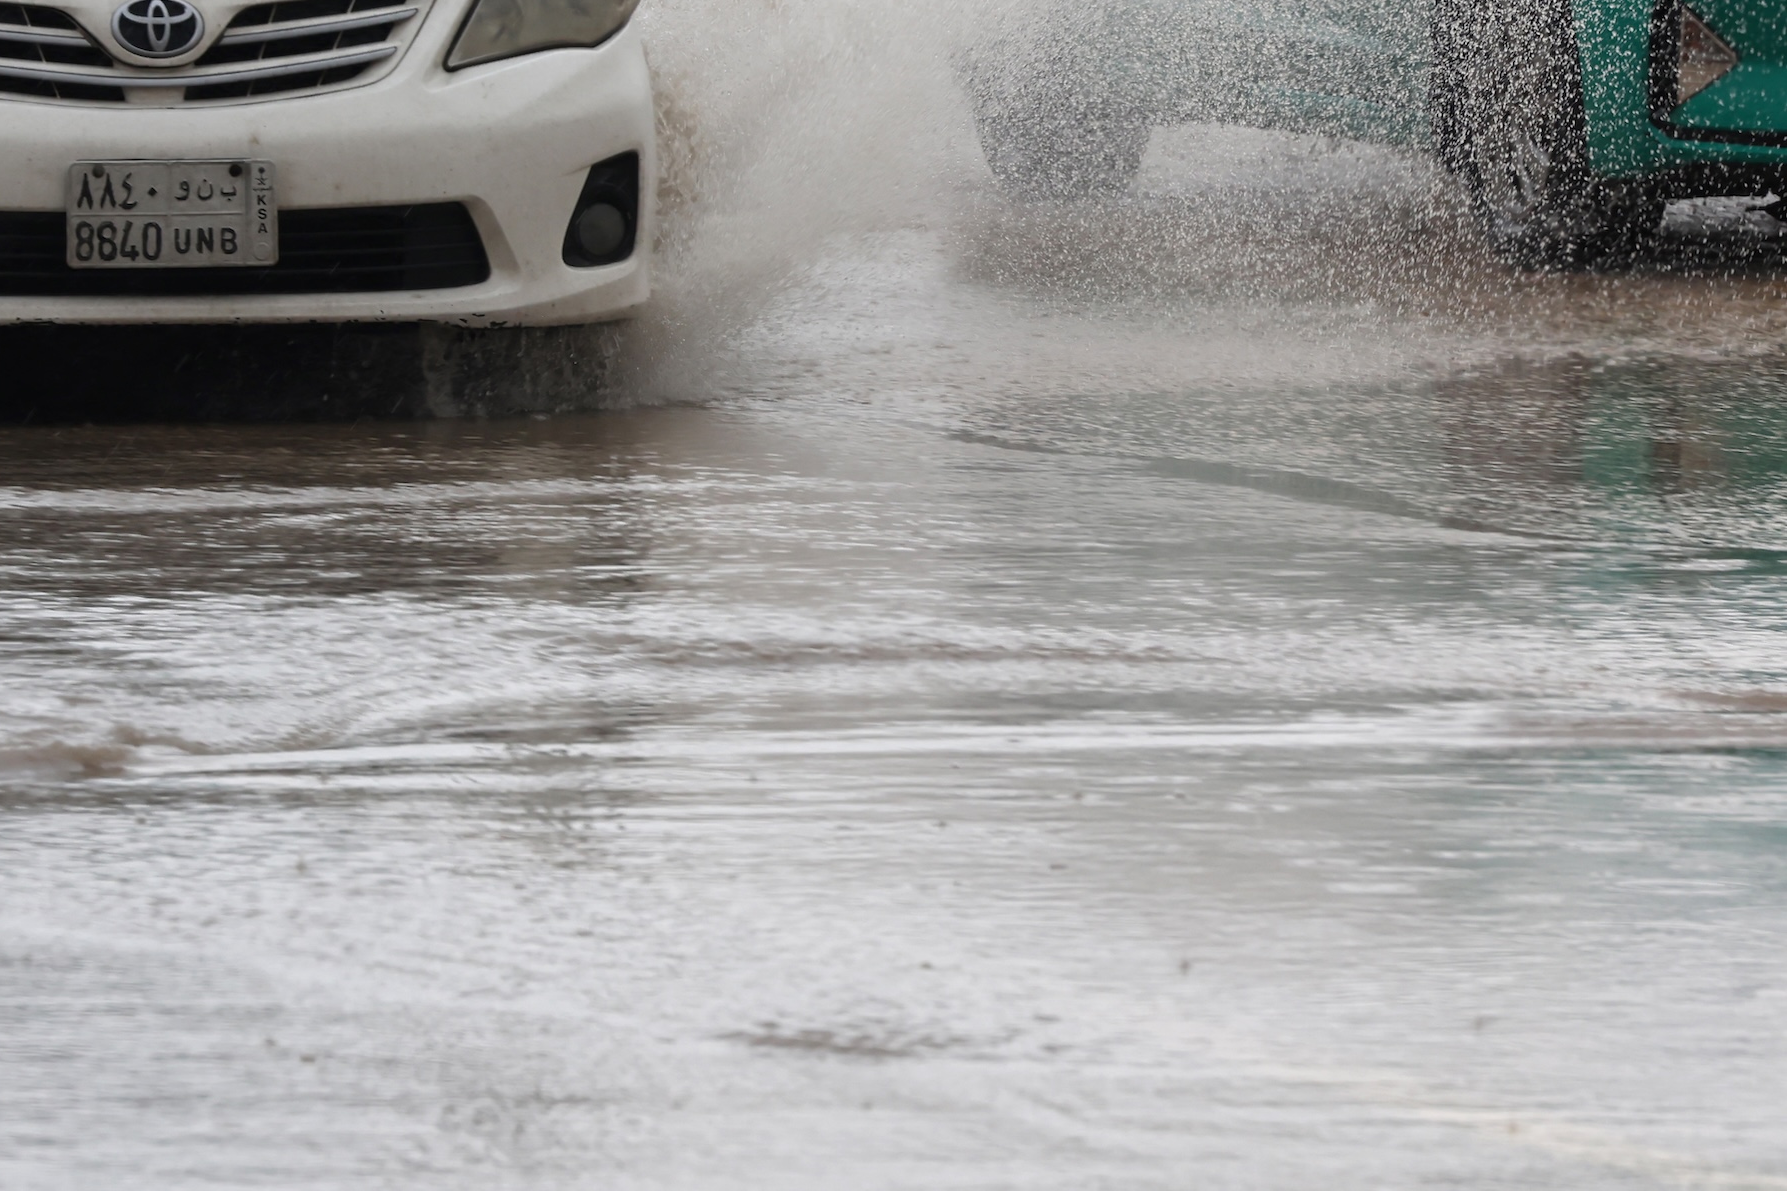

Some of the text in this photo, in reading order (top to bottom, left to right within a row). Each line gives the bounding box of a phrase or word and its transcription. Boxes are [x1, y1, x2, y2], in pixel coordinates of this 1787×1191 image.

[256, 194, 269, 234] KSA
[74, 220, 239, 262] 8840 UNB
